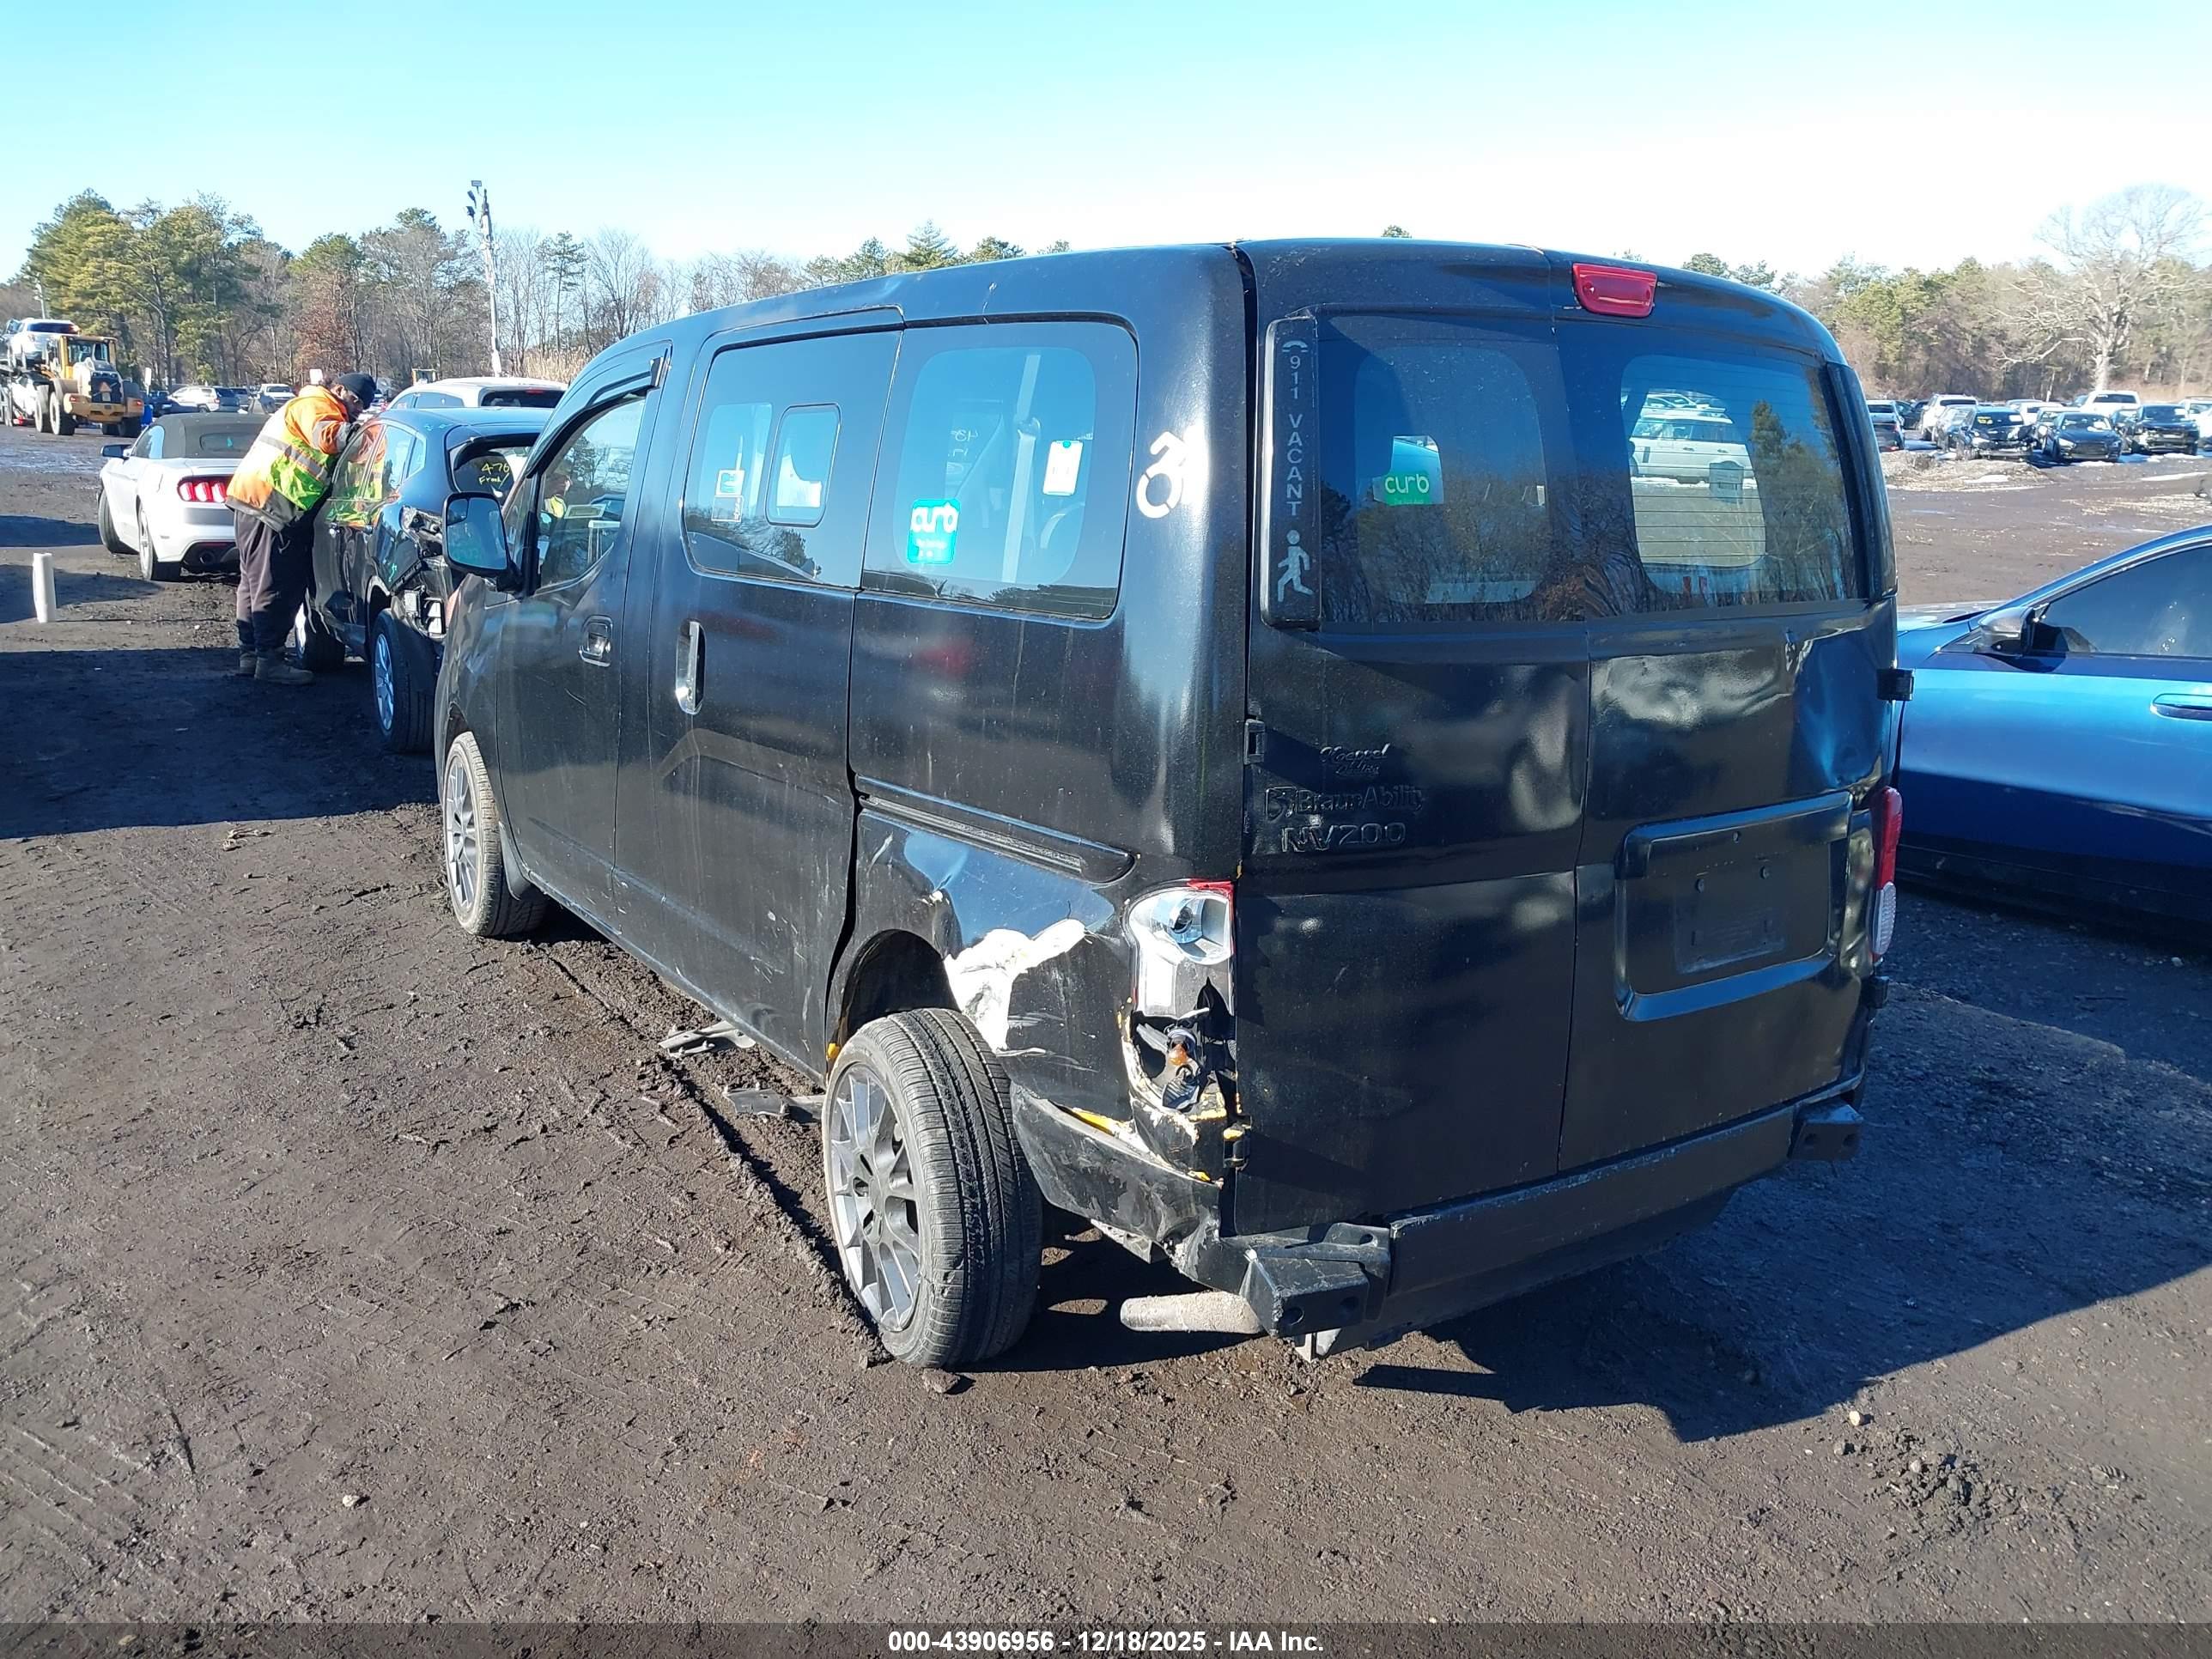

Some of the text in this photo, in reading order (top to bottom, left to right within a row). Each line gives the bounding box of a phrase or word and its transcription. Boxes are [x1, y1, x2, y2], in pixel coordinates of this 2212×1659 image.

[1286, 356, 1304, 516] 911 VACANT
[1384, 473, 1430, 494] curb
[1281, 822, 1407, 853] NV200
